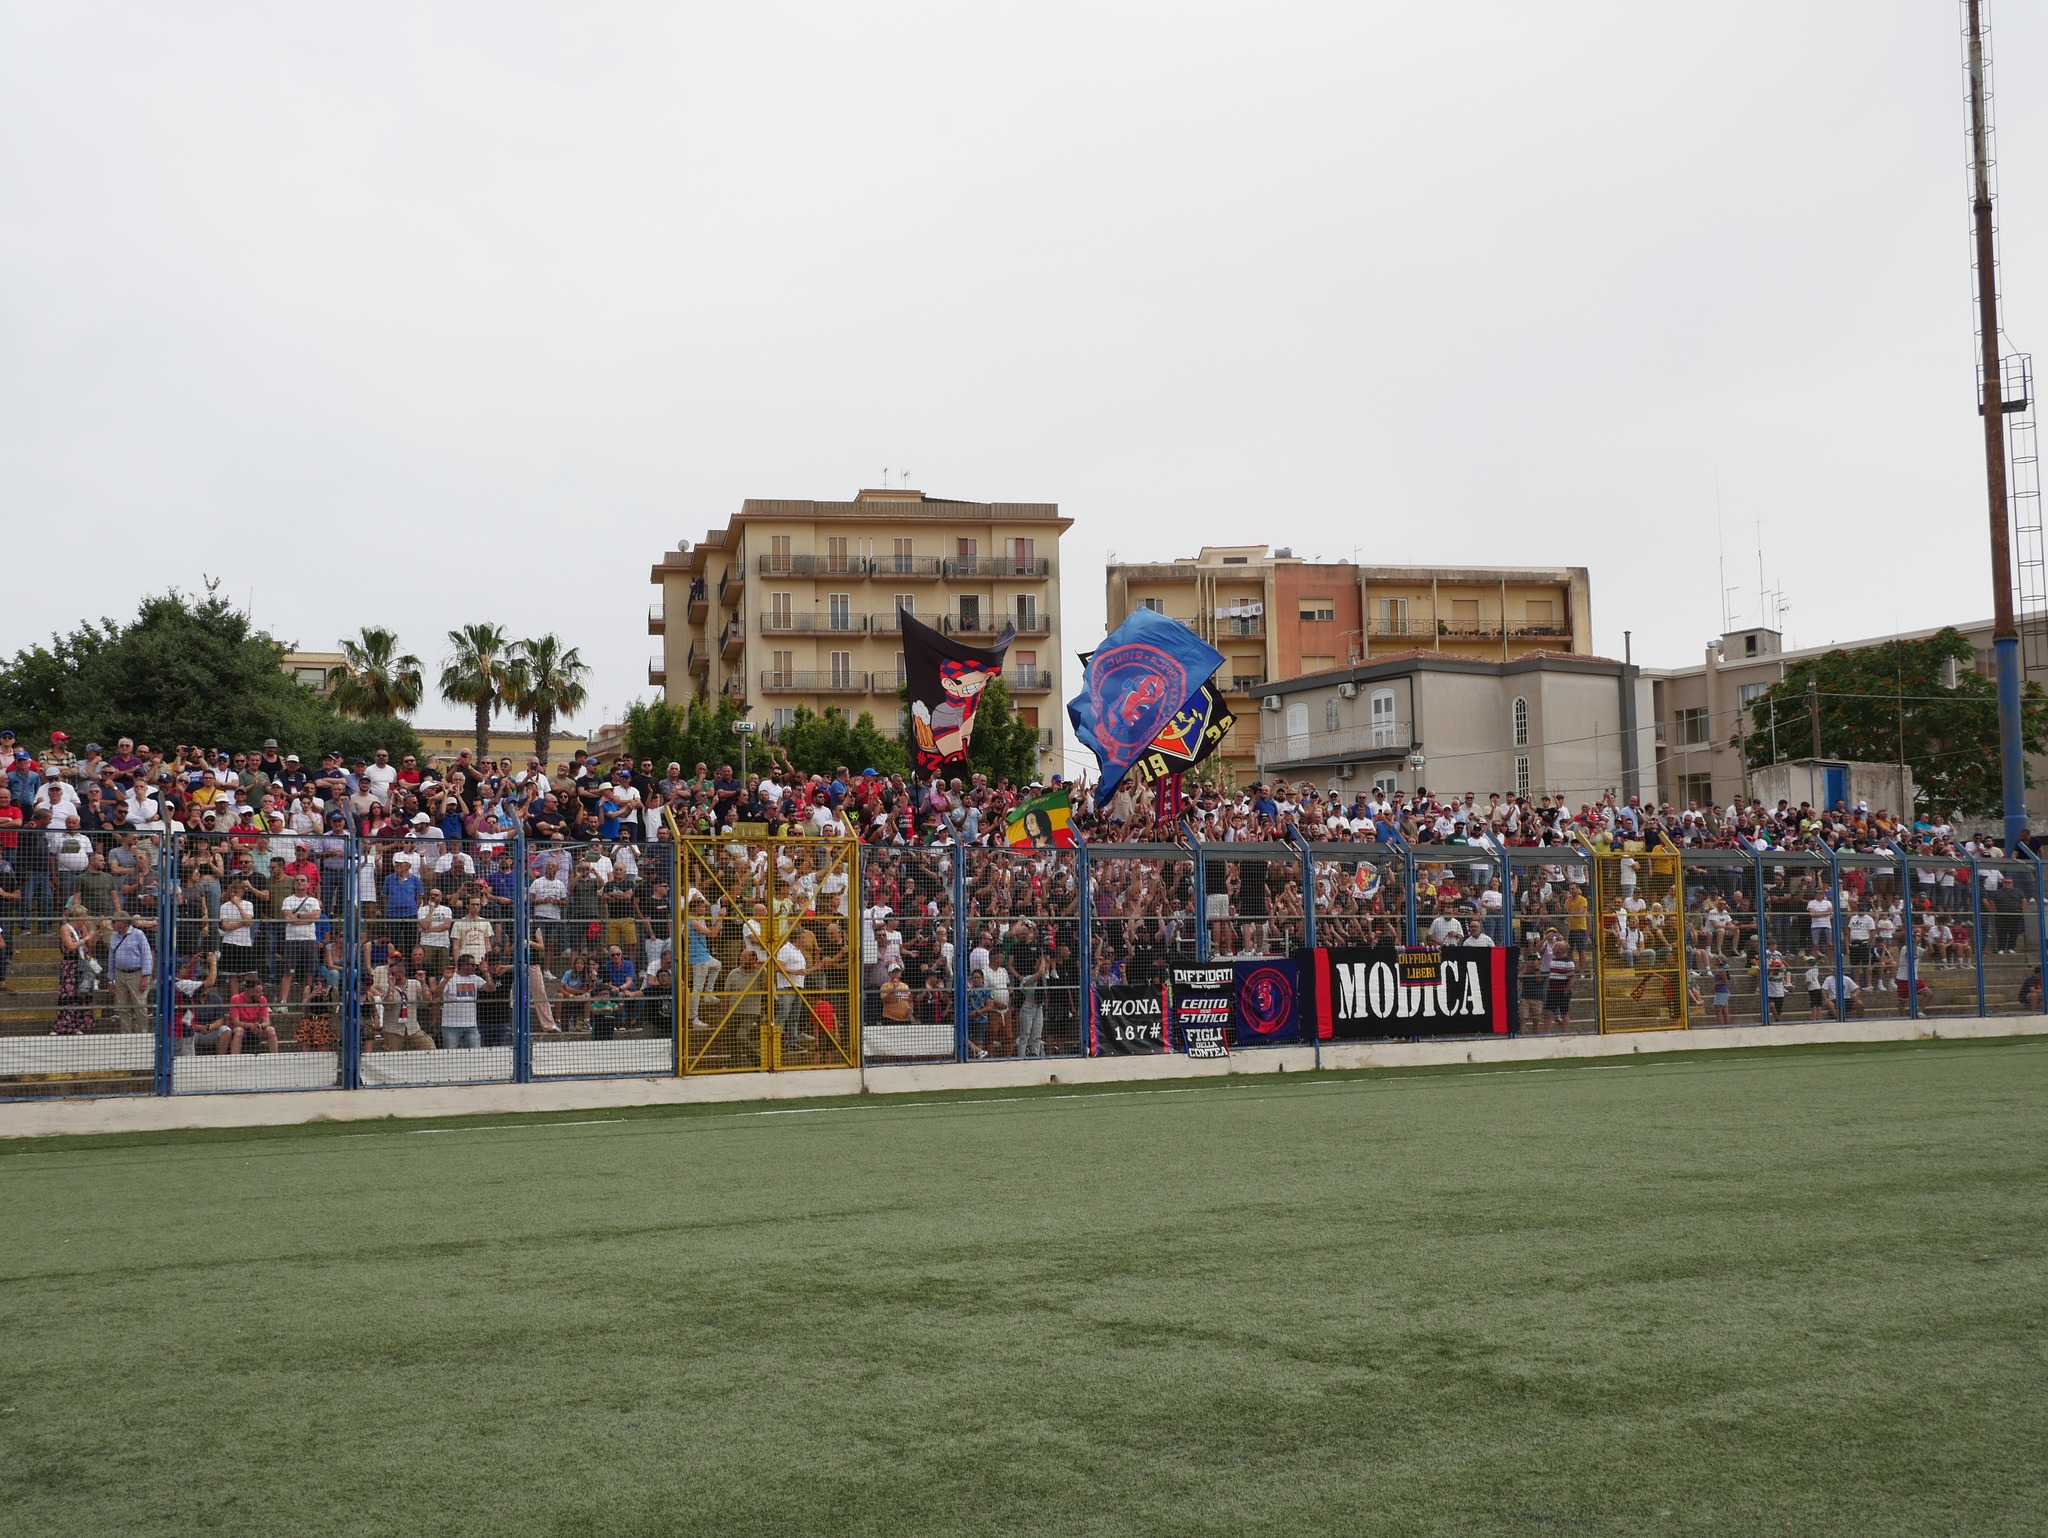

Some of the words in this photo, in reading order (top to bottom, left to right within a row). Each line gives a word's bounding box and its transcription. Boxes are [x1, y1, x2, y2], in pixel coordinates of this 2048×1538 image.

[1137, 753, 1169, 783] 19
[1398, 952, 1441, 965] DIFFIDATI
[1173, 968, 1233, 982] DIFFIDATI
[1406, 967, 1436, 979] LIBERI
[1335, 960, 1486, 1019] MODICA
[1100, 998, 1162, 1016] #ZONA
[1114, 1022, 1162, 1040] 167#
[1185, 1027, 1223, 1042] FIGLI
[1188, 1047, 1229, 1058] CONTEA
